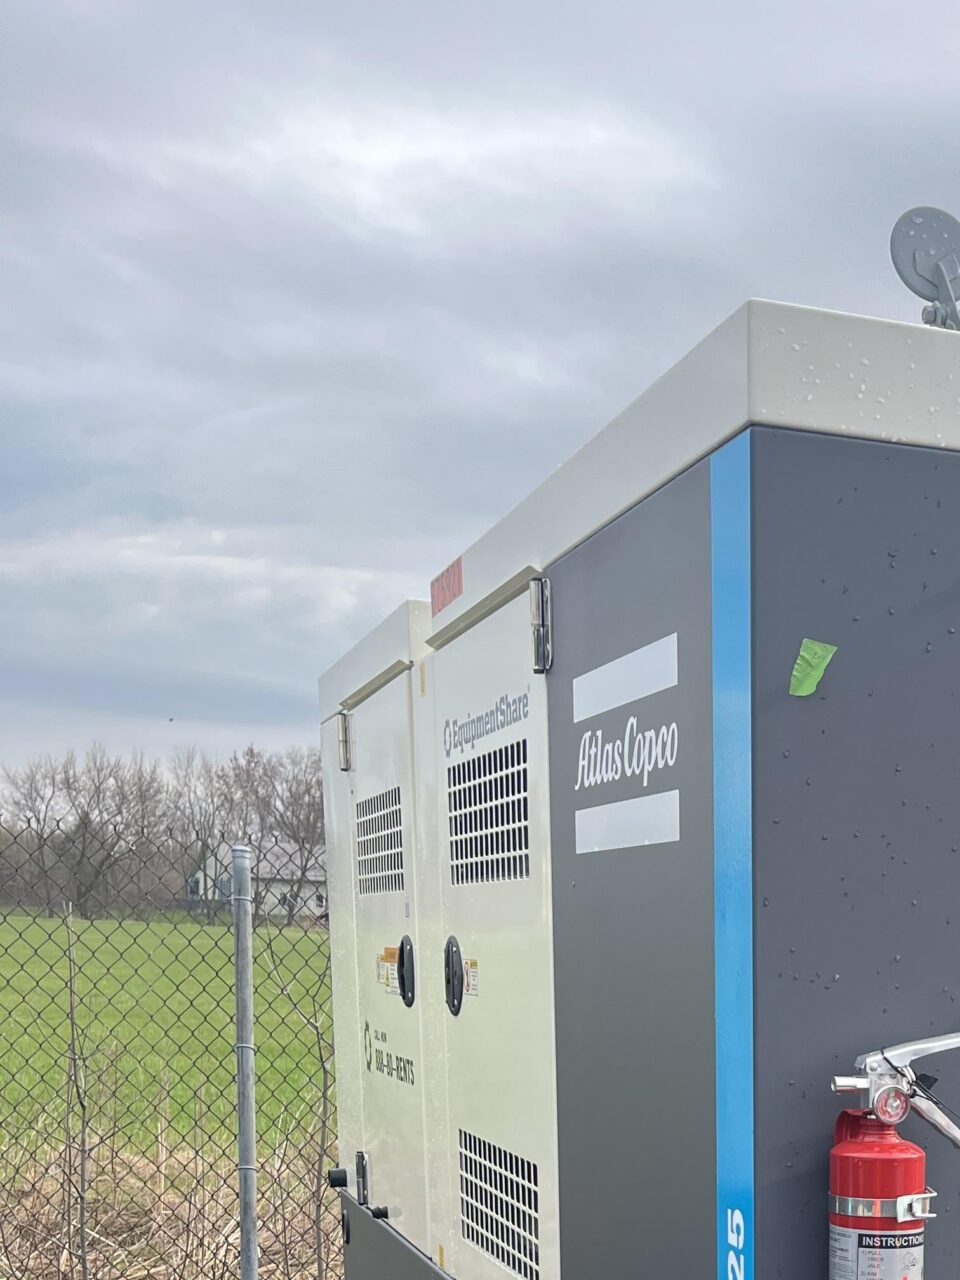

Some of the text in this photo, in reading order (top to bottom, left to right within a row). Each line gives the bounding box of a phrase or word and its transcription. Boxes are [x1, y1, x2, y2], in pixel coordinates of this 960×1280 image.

[452, 692, 529, 754] EquipmentShare
[574, 715, 679, 791] Atlas Copco
